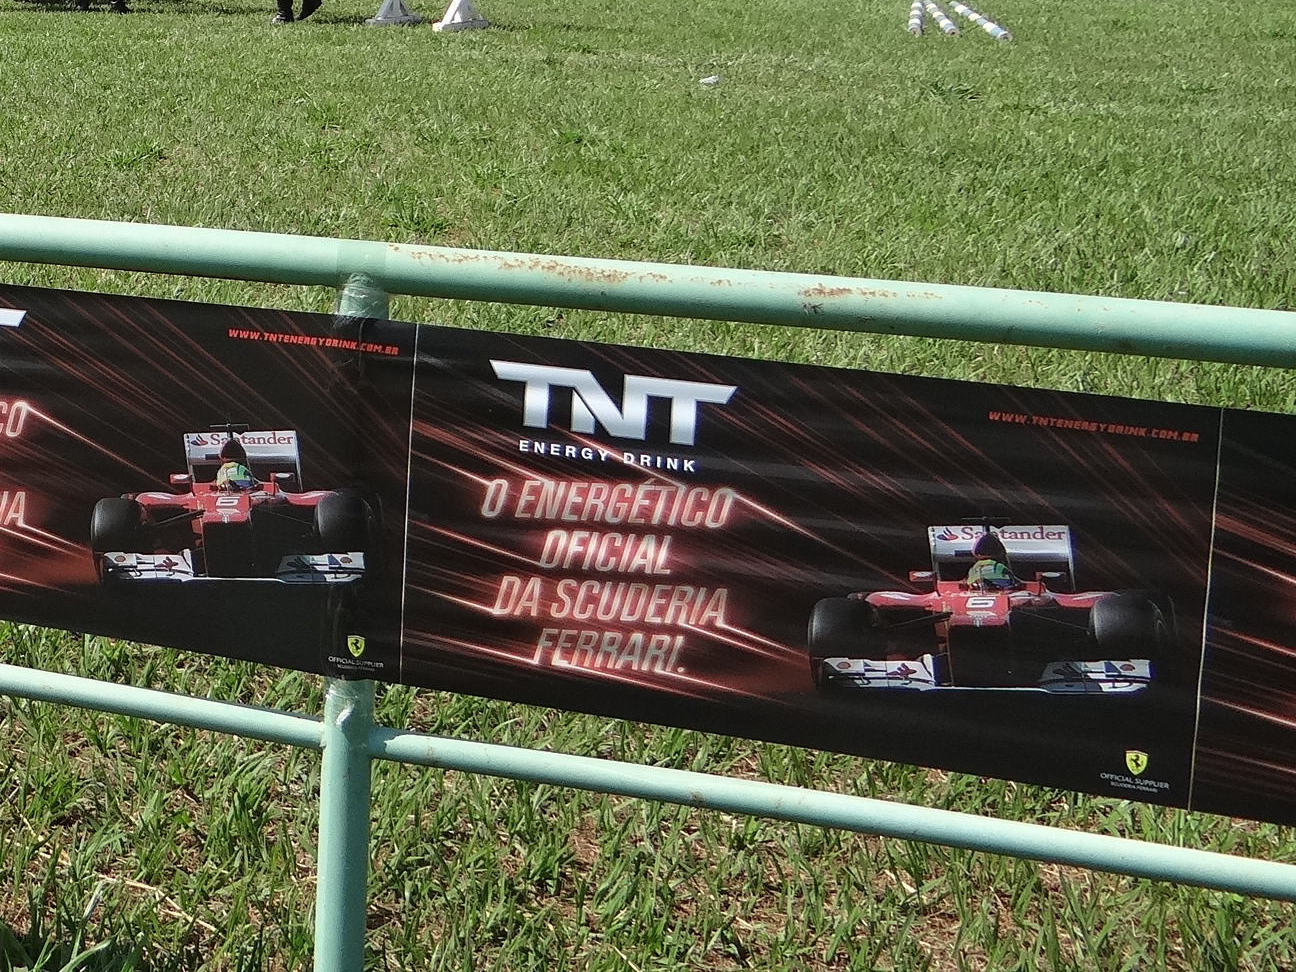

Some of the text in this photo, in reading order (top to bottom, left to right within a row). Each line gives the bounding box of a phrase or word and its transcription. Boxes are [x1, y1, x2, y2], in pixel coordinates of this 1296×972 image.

[228, 329, 399, 355] WWW.TNTENERGYDRINK.COM.BR
[489, 359, 738, 446] TNT
[210, 432, 293, 446] Satander
[988, 411, 1200, 442] WWW.TNTENERGYDRINK.COM.BR
[519, 440, 696, 472] ENERGY DRINK
[481, 478, 734, 528] O ENERGÉTICO
[960, 526, 1065, 541] Satander
[540, 529, 671, 574] OFICIAL
[494, 575, 728, 626] DA SCUDERIA
[328, 656, 384, 668] OFFICIAL SUPPLIER
[534, 628, 685, 673] FERRARI.
[1100, 773, 1170, 789] OFFICIAL SUPPLIER
